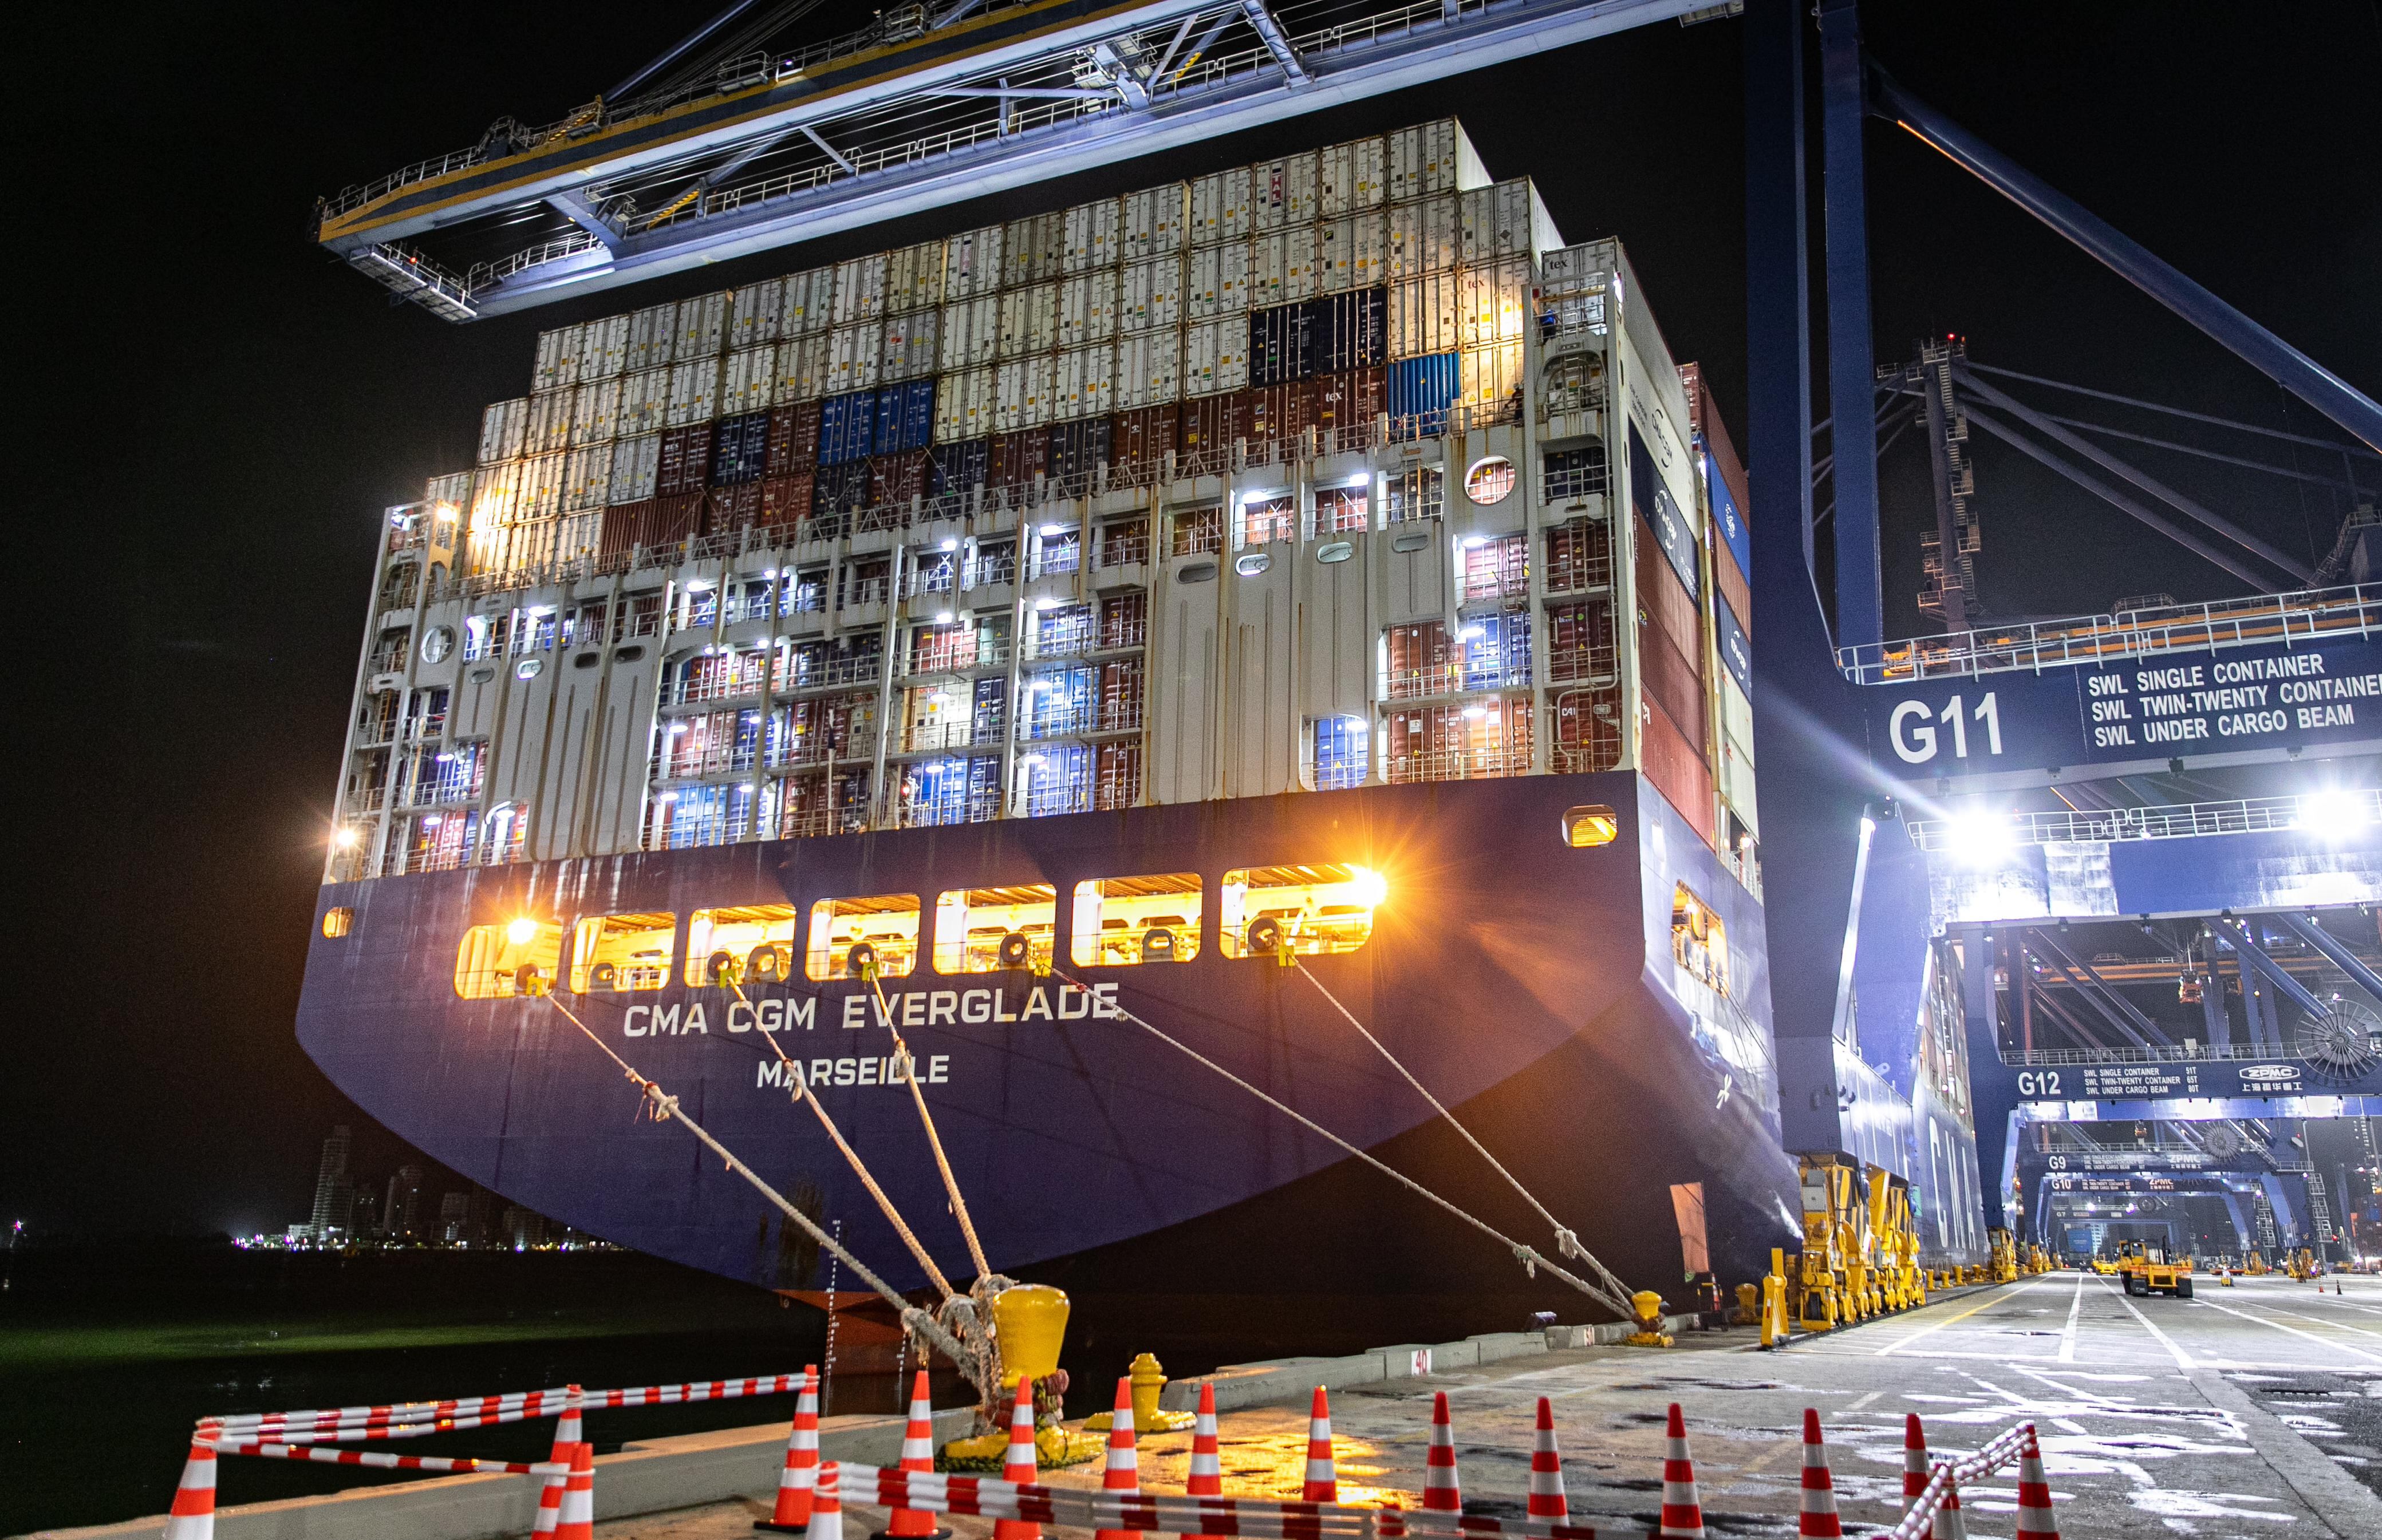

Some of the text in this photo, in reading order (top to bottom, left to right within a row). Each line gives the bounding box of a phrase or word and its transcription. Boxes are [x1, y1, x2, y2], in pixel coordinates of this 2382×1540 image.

[1549, 259, 1568, 270] tex
[1468, 279, 1485, 289] tex
[1325, 392, 1342, 402] tex
[2088, 653, 2325, 697] SWL SINGLE CONTAINER
[2091, 699, 2132, 722] SWL
[2139, 684, 2269, 717] TWIN-TWENTY
[1889, 692, 2003, 764] G11
[2095, 704, 2355, 748] SWL UNDER CARGO BEAM
[791, 786, 806, 796] tex
[623, 982, 1120, 1037] CMA CGM EVERGLADE
[757, 1055, 950, 1088] MARSEILLE
[2084, 1067, 2196, 1077] SWL SINGLE CONTAINER 51T
[2248, 1068, 2293, 1077] ZPMC
[2018, 1071, 2061, 1095] G12
[2084, 1075, 2198, 1086] SWL TWIN-TWENTY CONTAINER 65T
[2101, 1086, 2124, 1094] UNDER
[2125, 1085, 2147, 1094] CARGO
[2150, 1085, 2168, 1093] BEAM
[2188, 1084, 2199, 1092] 80T
[2049, 1155, 2066, 1169] G9
[2170, 1154, 2200, 1163] ZPMC
[2052, 1179, 2071, 1190] G10
[1416, 1349, 1427, 1375] 40
